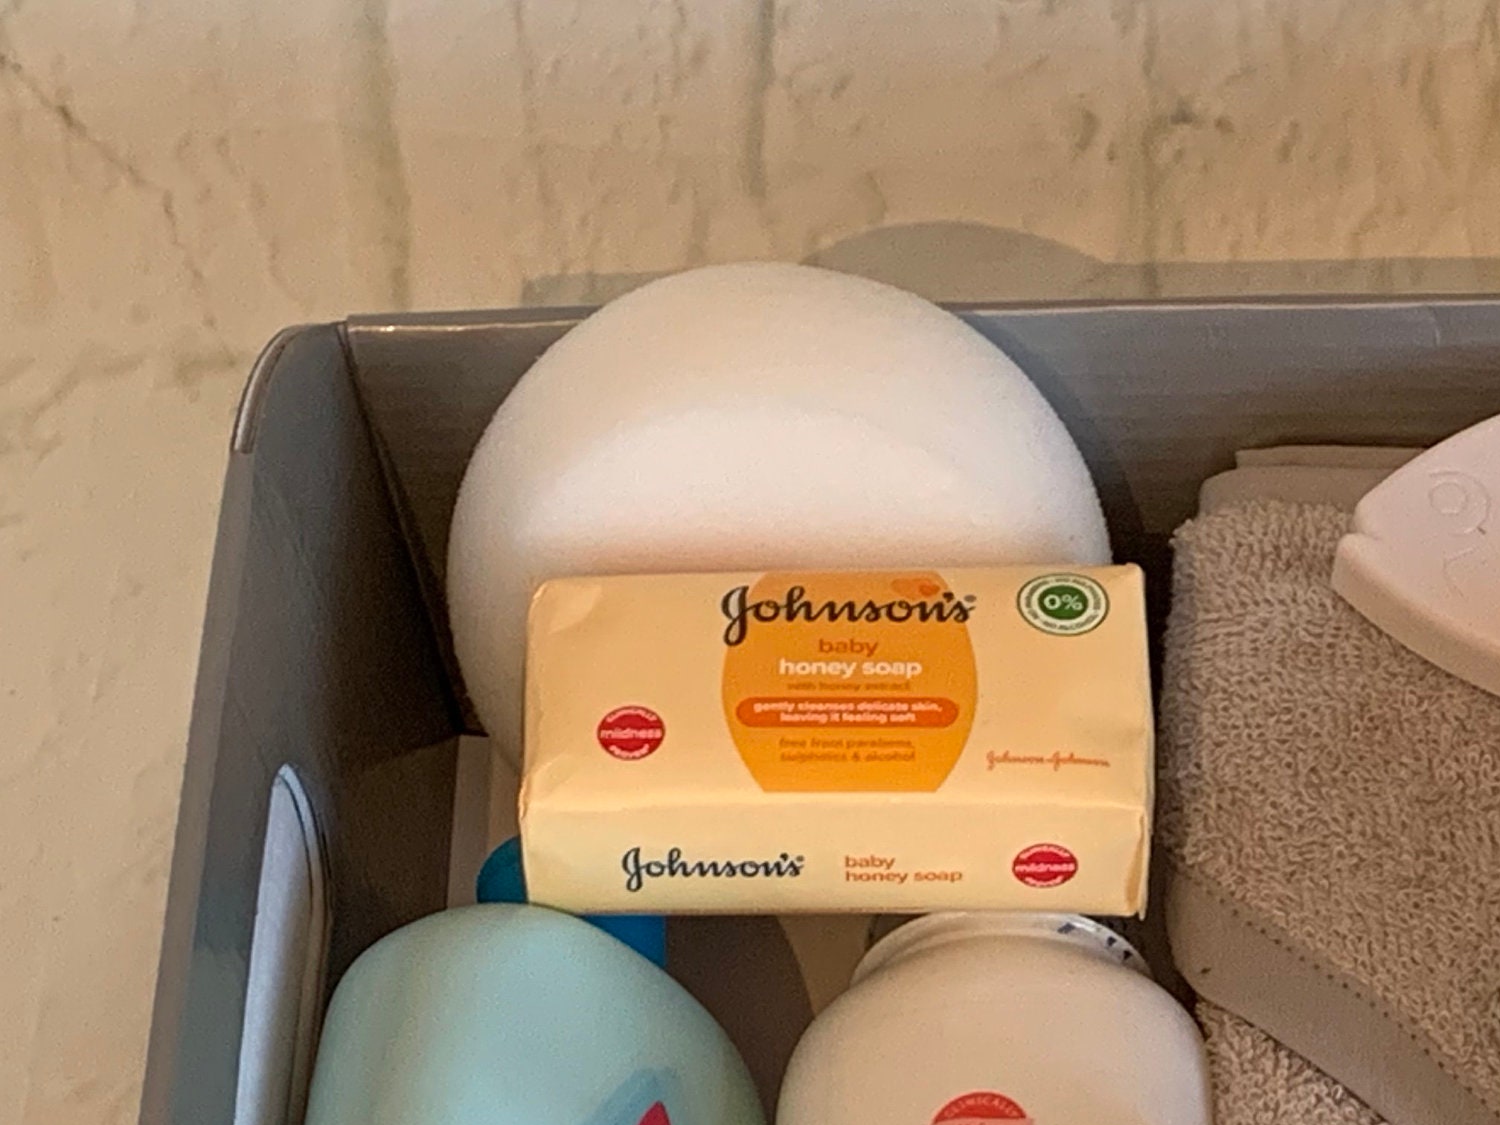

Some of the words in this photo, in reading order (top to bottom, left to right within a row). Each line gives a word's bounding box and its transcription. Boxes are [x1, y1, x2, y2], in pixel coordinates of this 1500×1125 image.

[1043, 594, 1084, 611] 0%
[721, 585, 976, 647] Johnson's
[819, 639, 879, 657] baby
[778, 658, 857, 679] honey
[862, 660, 923, 680] soap
[753, 701, 795, 713] gently
[857, 702, 908, 712] delicate
[780, 713, 828, 724] leaving
[842, 713, 888, 724] feeling
[889, 713, 916, 722] soft
[621, 847, 805, 892] Johnson's
[845, 855, 895, 870] baby
[845, 870, 908, 884] honey
[913, 871, 963, 885] soap
